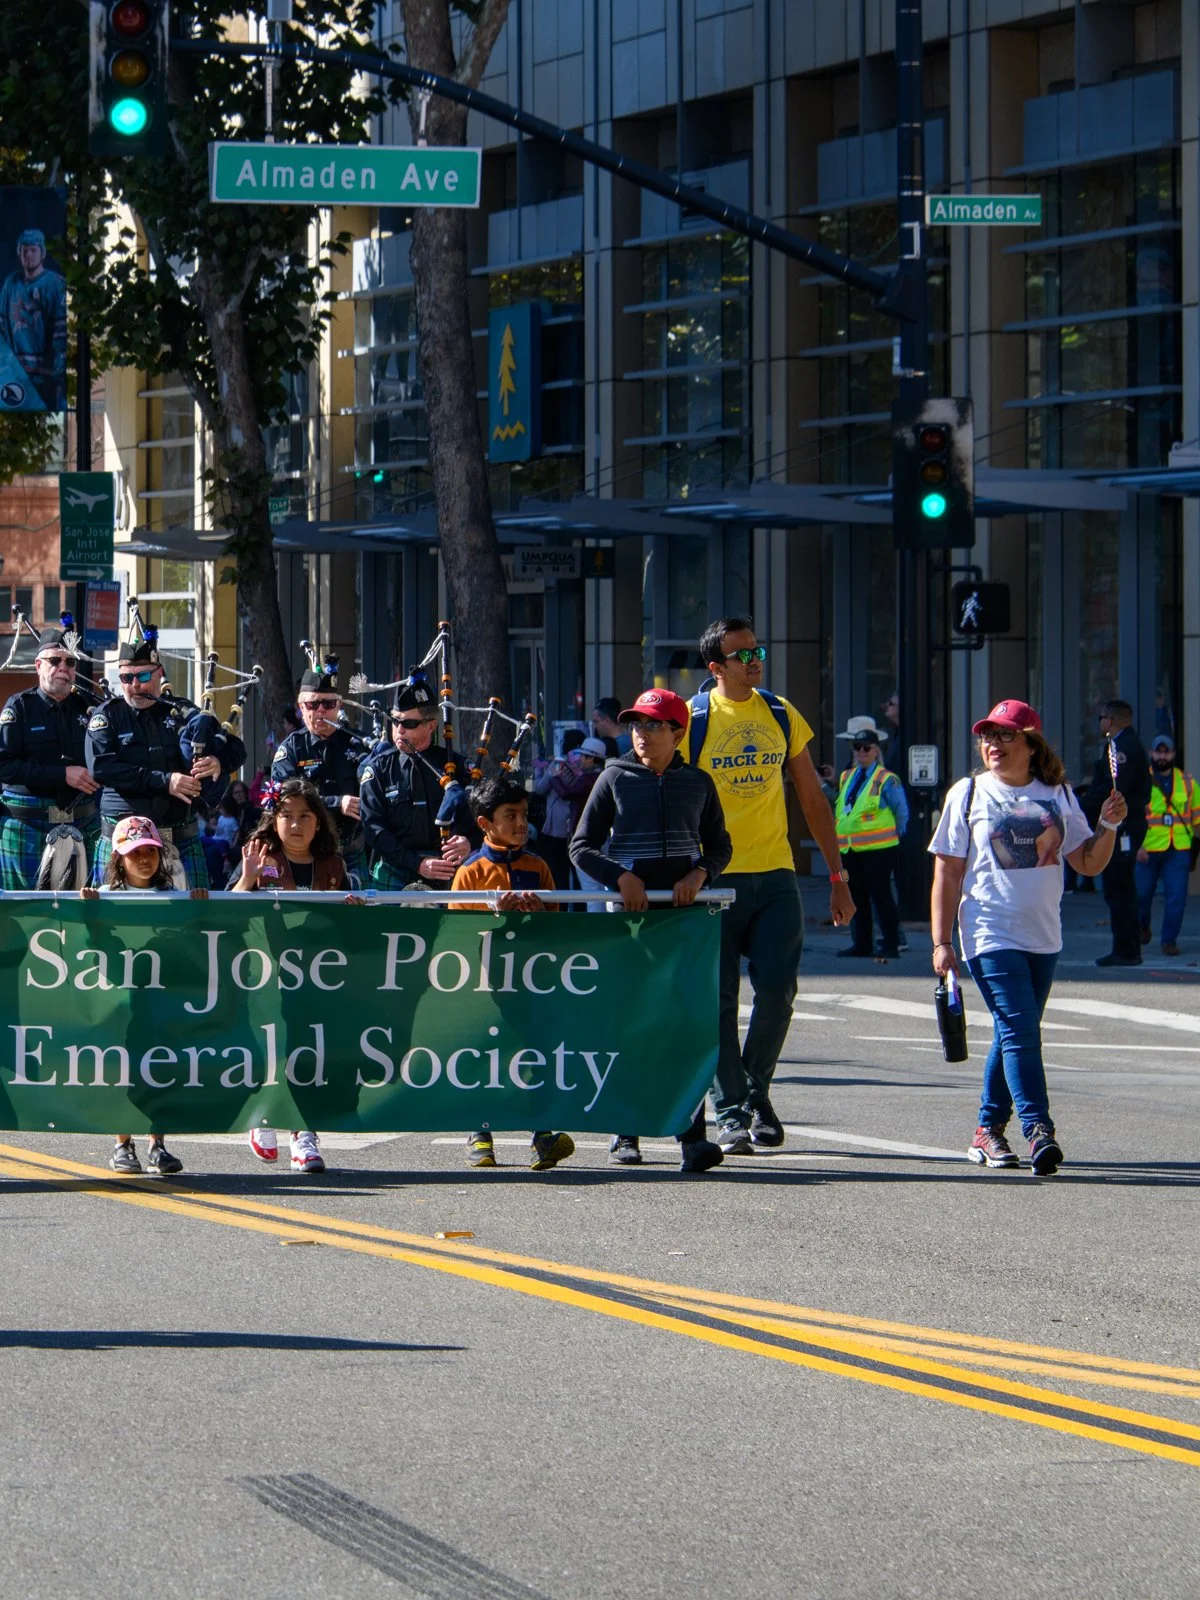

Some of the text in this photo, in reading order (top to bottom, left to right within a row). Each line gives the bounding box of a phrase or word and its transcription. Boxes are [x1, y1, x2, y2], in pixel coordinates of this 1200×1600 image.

[235, 159, 459, 191] Almaden Ave
[933, 200, 1037, 220] Almaden Av
[64, 527, 110, 537] San Jose
[77, 538, 97, 549] Intl
[66, 551, 108, 562] Airport
[521, 551, 575, 562] UMPQUA
[711, 753, 783, 769] PACK 207
[1013, 835, 1034, 845] Kisses
[27, 929, 598, 1013] San Jose Police
[8, 1023, 619, 1111] Emerald Society
